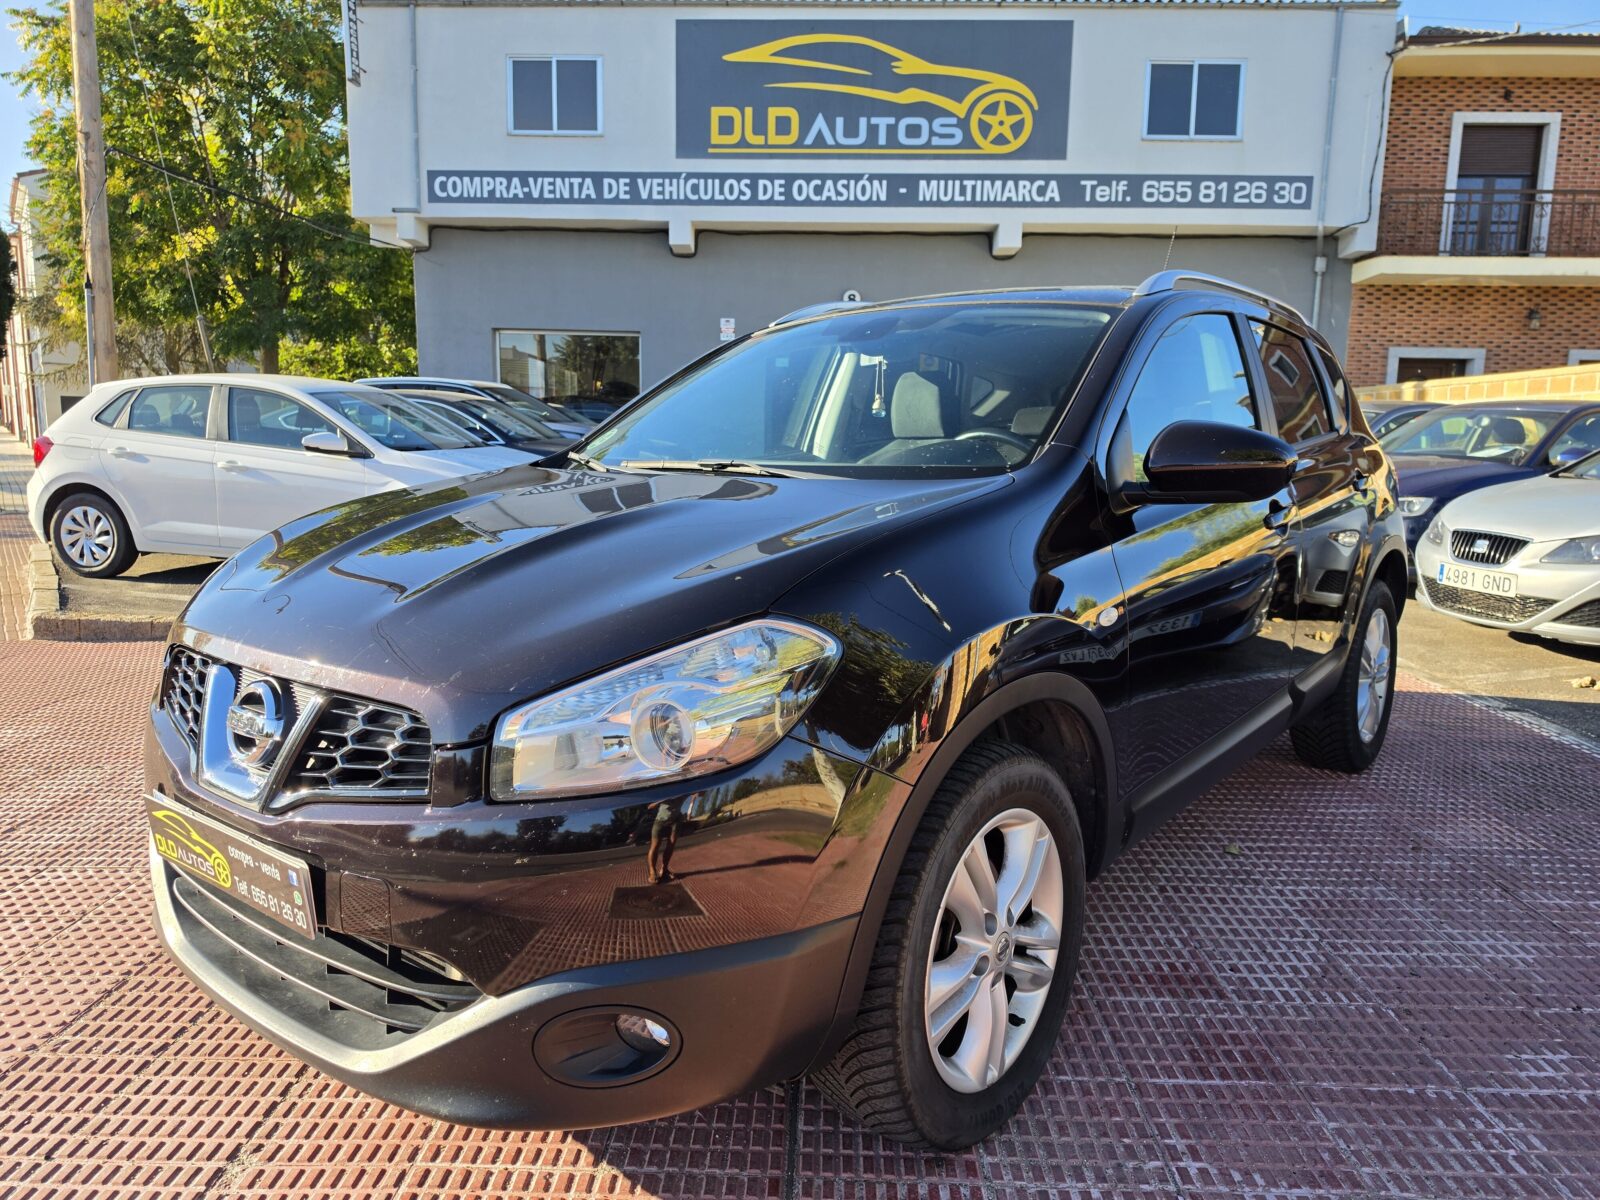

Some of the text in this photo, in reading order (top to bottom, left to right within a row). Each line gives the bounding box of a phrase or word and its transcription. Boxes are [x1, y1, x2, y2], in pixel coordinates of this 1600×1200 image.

[710, 106, 964, 146] DLD AUTOS
[433, 175, 597, 199] COMPRA-VENTA
[602, 177, 631, 200] DE
[637, 173, 752, 201] VEHÍCULOS
[757, 179, 786, 201] DE
[792, 174, 888, 202] OCASIÓN
[918, 179, 1060, 203] MULTIMARCA
[1080, 180, 1131, 203] Telf.
[1141, 181, 1193, 203] 655
[1272, 182, 1308, 204] 30
[1445, 567, 1513, 594] 4981 GND
[155, 833, 215, 876] DLD AUTOS
[228, 845, 254, 868] compra
[260, 862, 281, 881] venta
[251, 885, 268, 907] 655
[268, 894, 280, 915] 81
[281, 901, 294, 922] 26
[294, 908, 307, 929] 30
